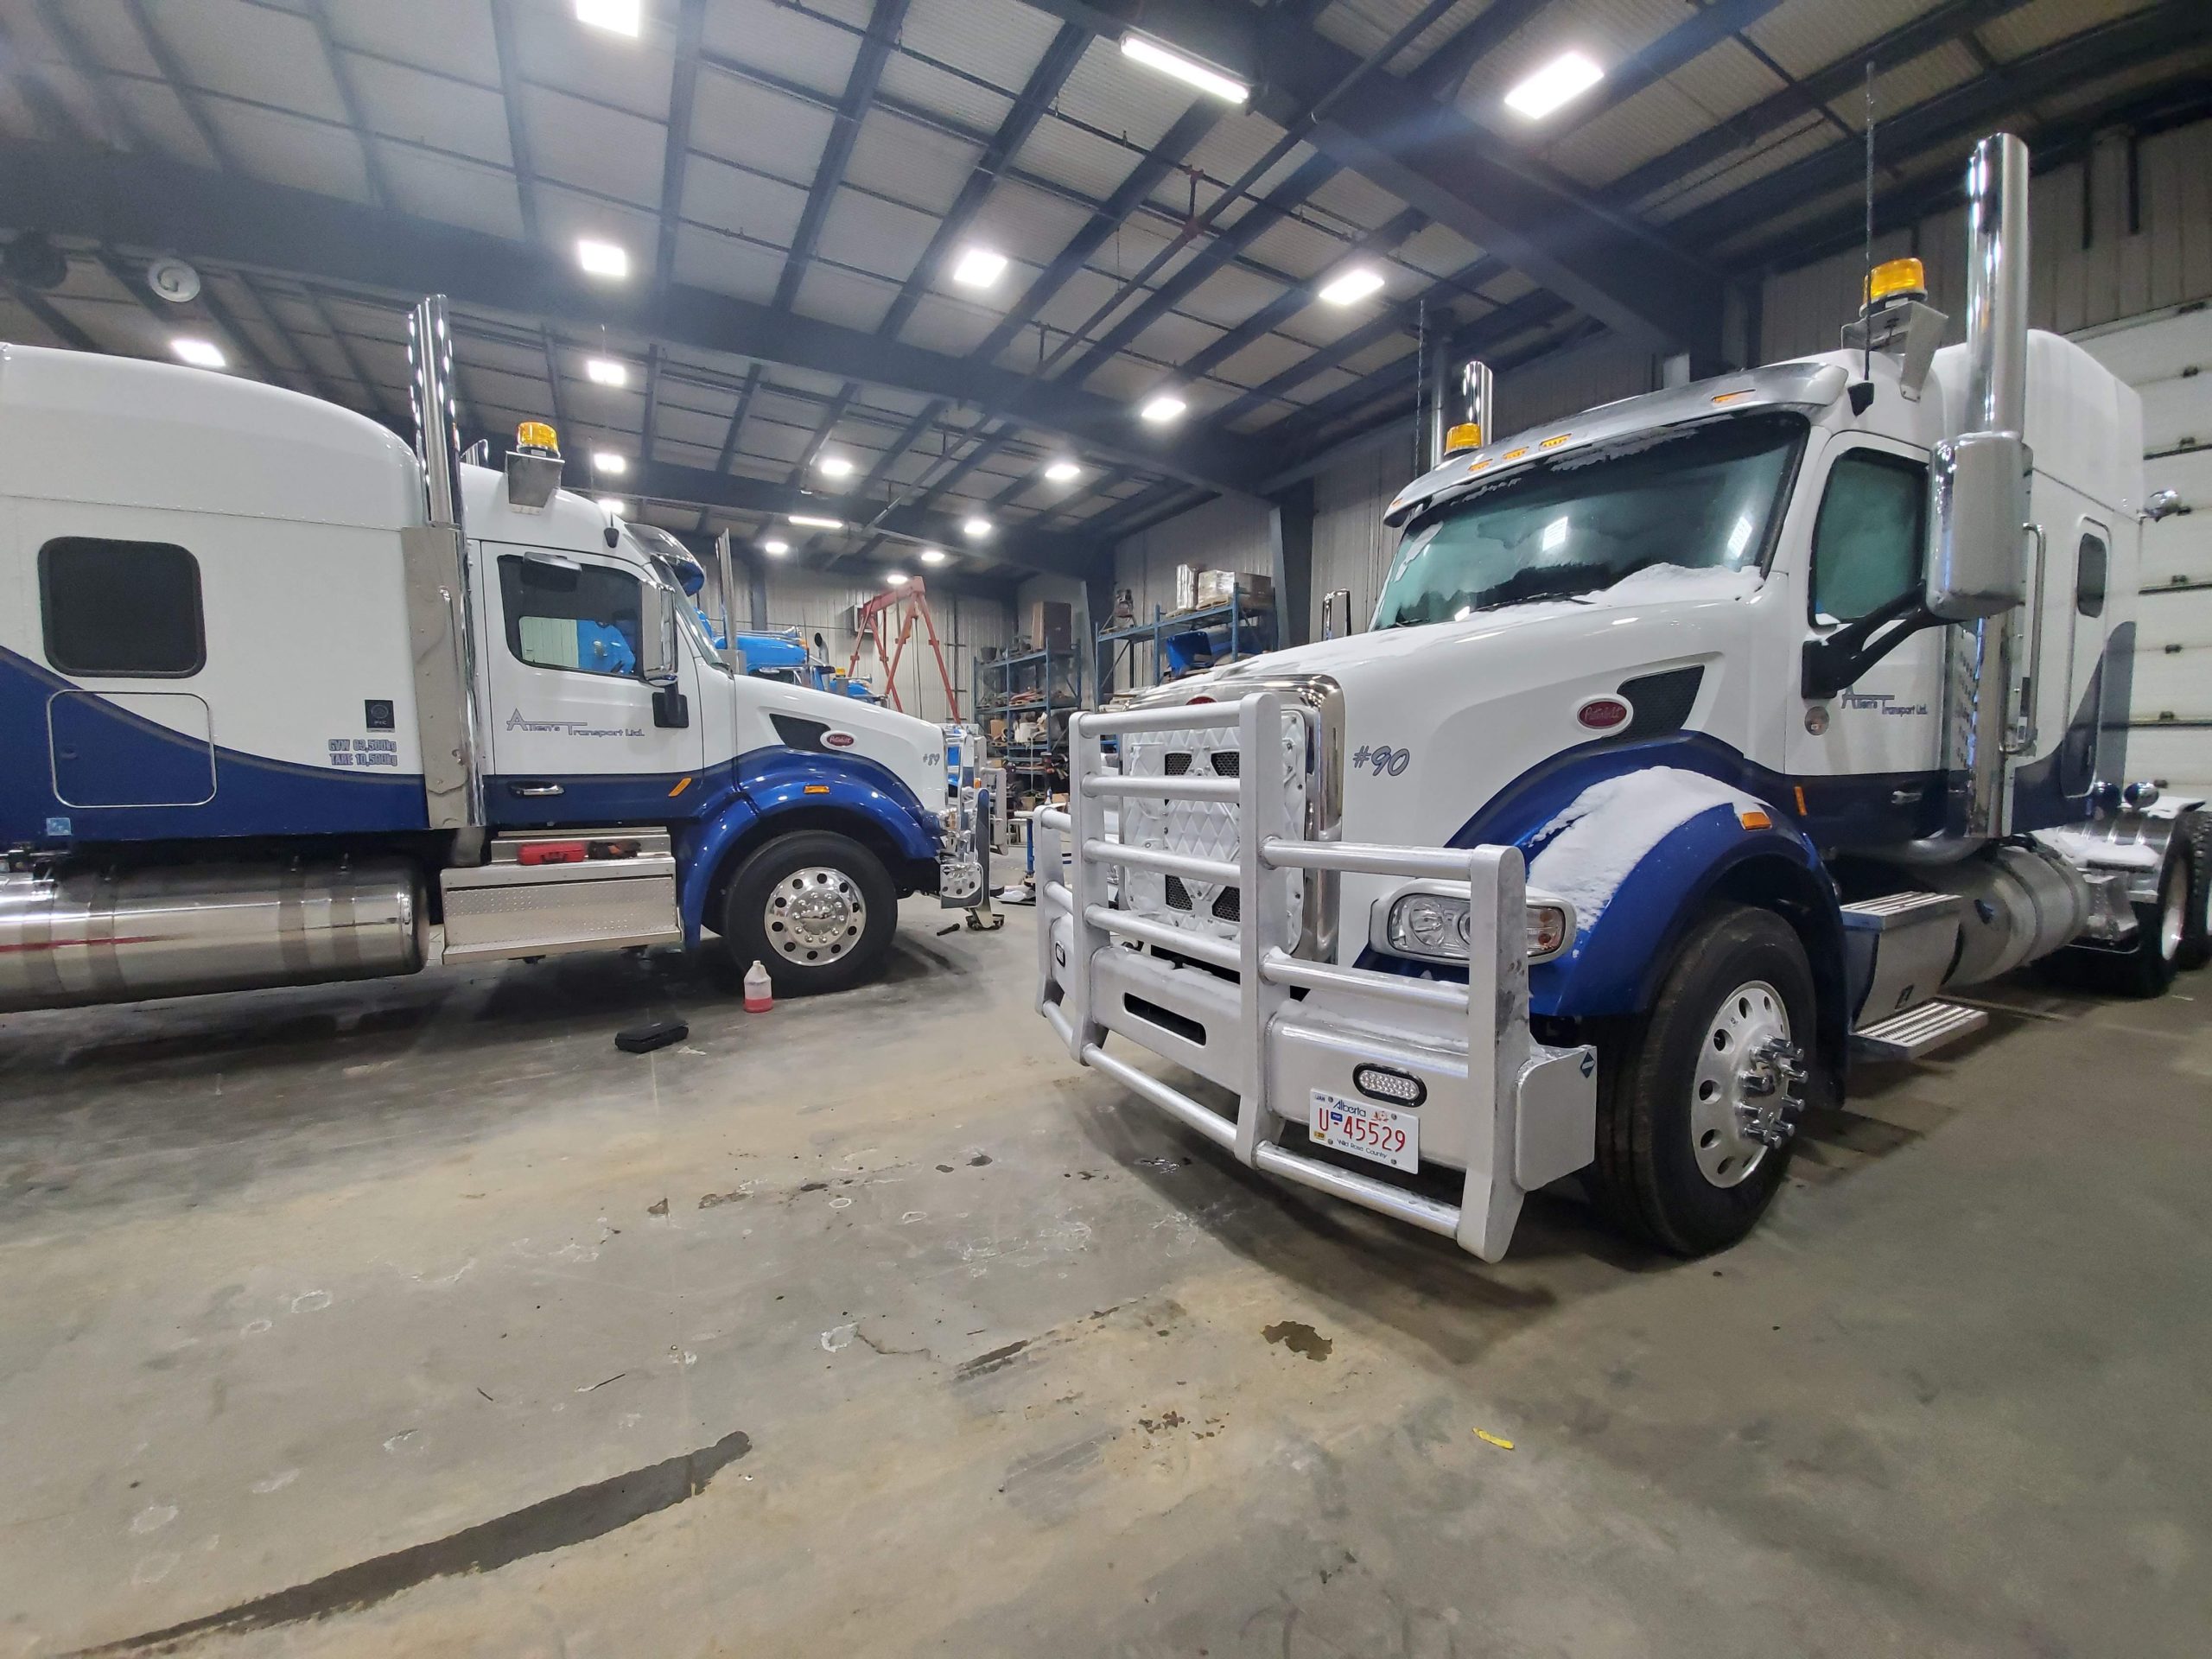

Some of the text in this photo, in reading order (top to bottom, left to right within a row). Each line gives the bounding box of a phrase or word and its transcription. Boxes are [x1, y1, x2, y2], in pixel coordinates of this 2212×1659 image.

[567, 722, 623, 737] Transport
[328, 739, 350, 751] GVW
[329, 753, 353, 766] TARE
[923, 753, 940, 766] #89
[1352, 745, 1410, 776] #90
[1333, 1100, 1366, 1117] Alberta
[1319, 1108, 1405, 1152] U-45529
[1337, 1138, 1388, 1158] Wild Rose Country
